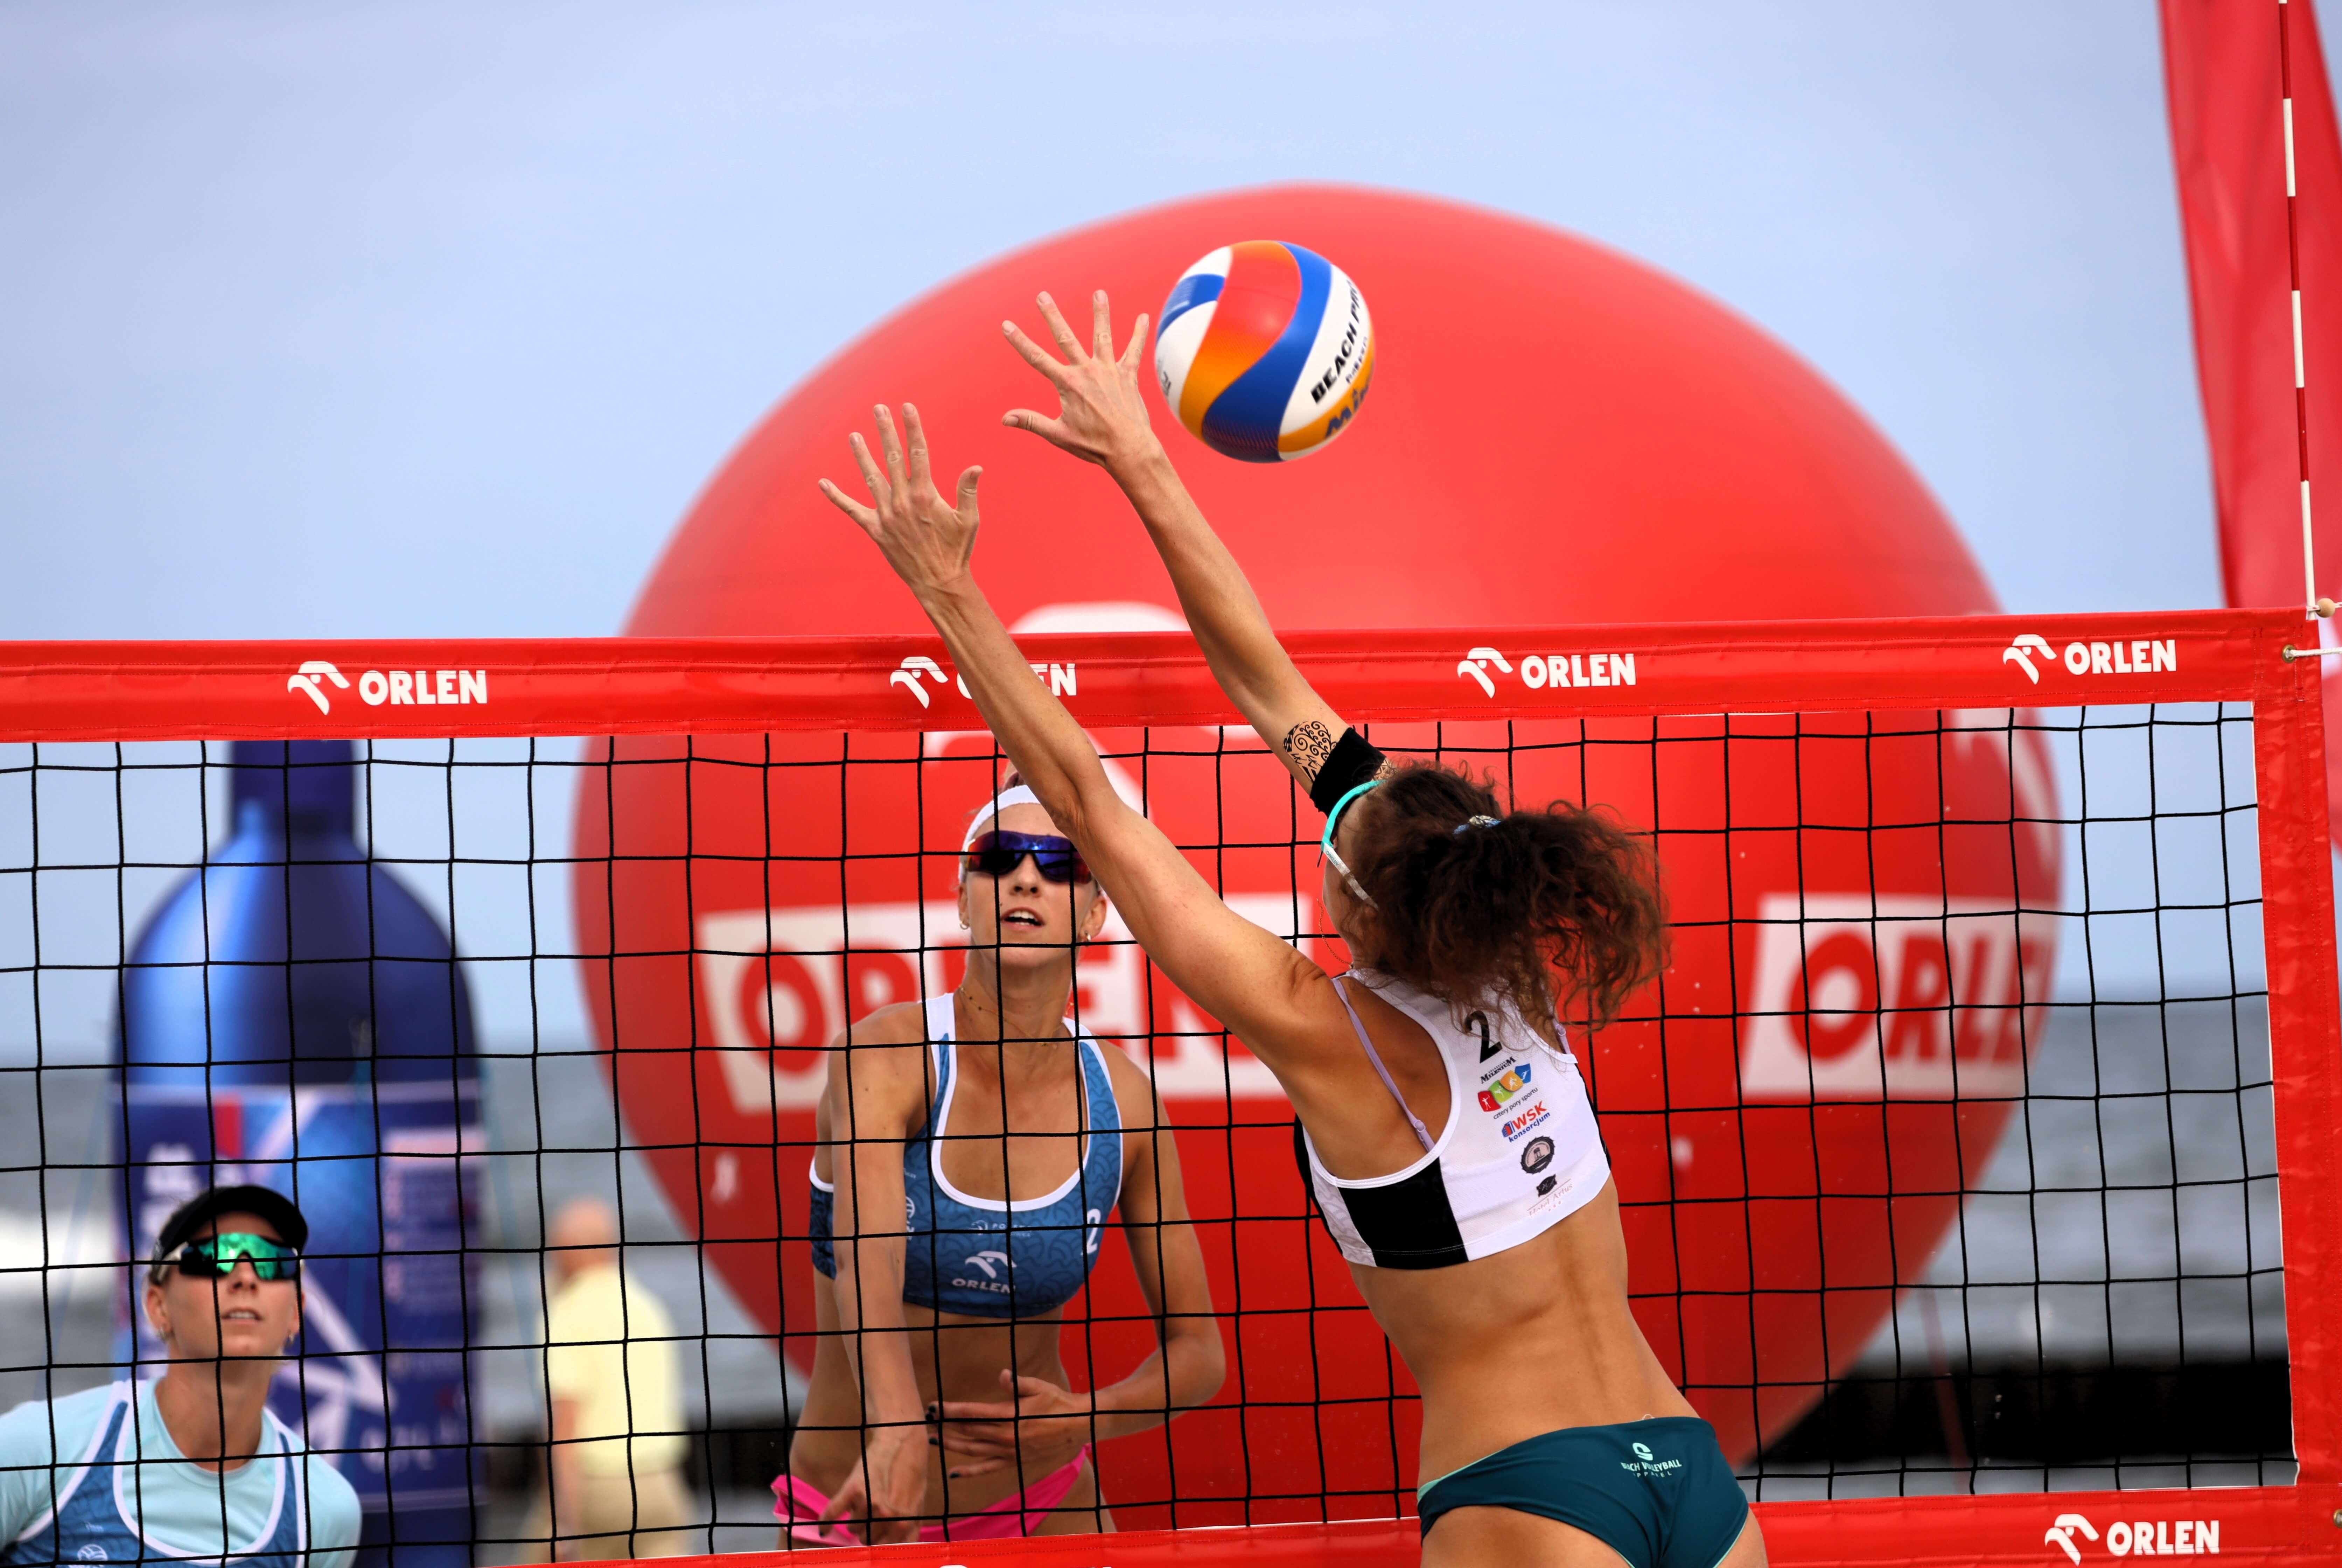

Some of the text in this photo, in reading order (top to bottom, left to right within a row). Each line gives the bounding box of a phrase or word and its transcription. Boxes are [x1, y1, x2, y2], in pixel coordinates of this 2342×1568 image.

[1310, 322, 1357, 404] BEACH
[1521, 653, 1636, 689] ORLEN
[2065, 639, 2176, 675] ORLEN
[359, 670, 487, 705] ORLEN
[1464, 1010, 1503, 1063] 2
[1493, 1087, 1538, 1120] cztery pory sportu
[1512, 1100, 1547, 1130] WSK
[1509, 1112, 1550, 1142] konsorcjum
[1081, 1209, 1101, 1255] 2
[952, 1278, 1016, 1294] ORLEN
[2107, 1520, 2220, 1556] ORLEN
